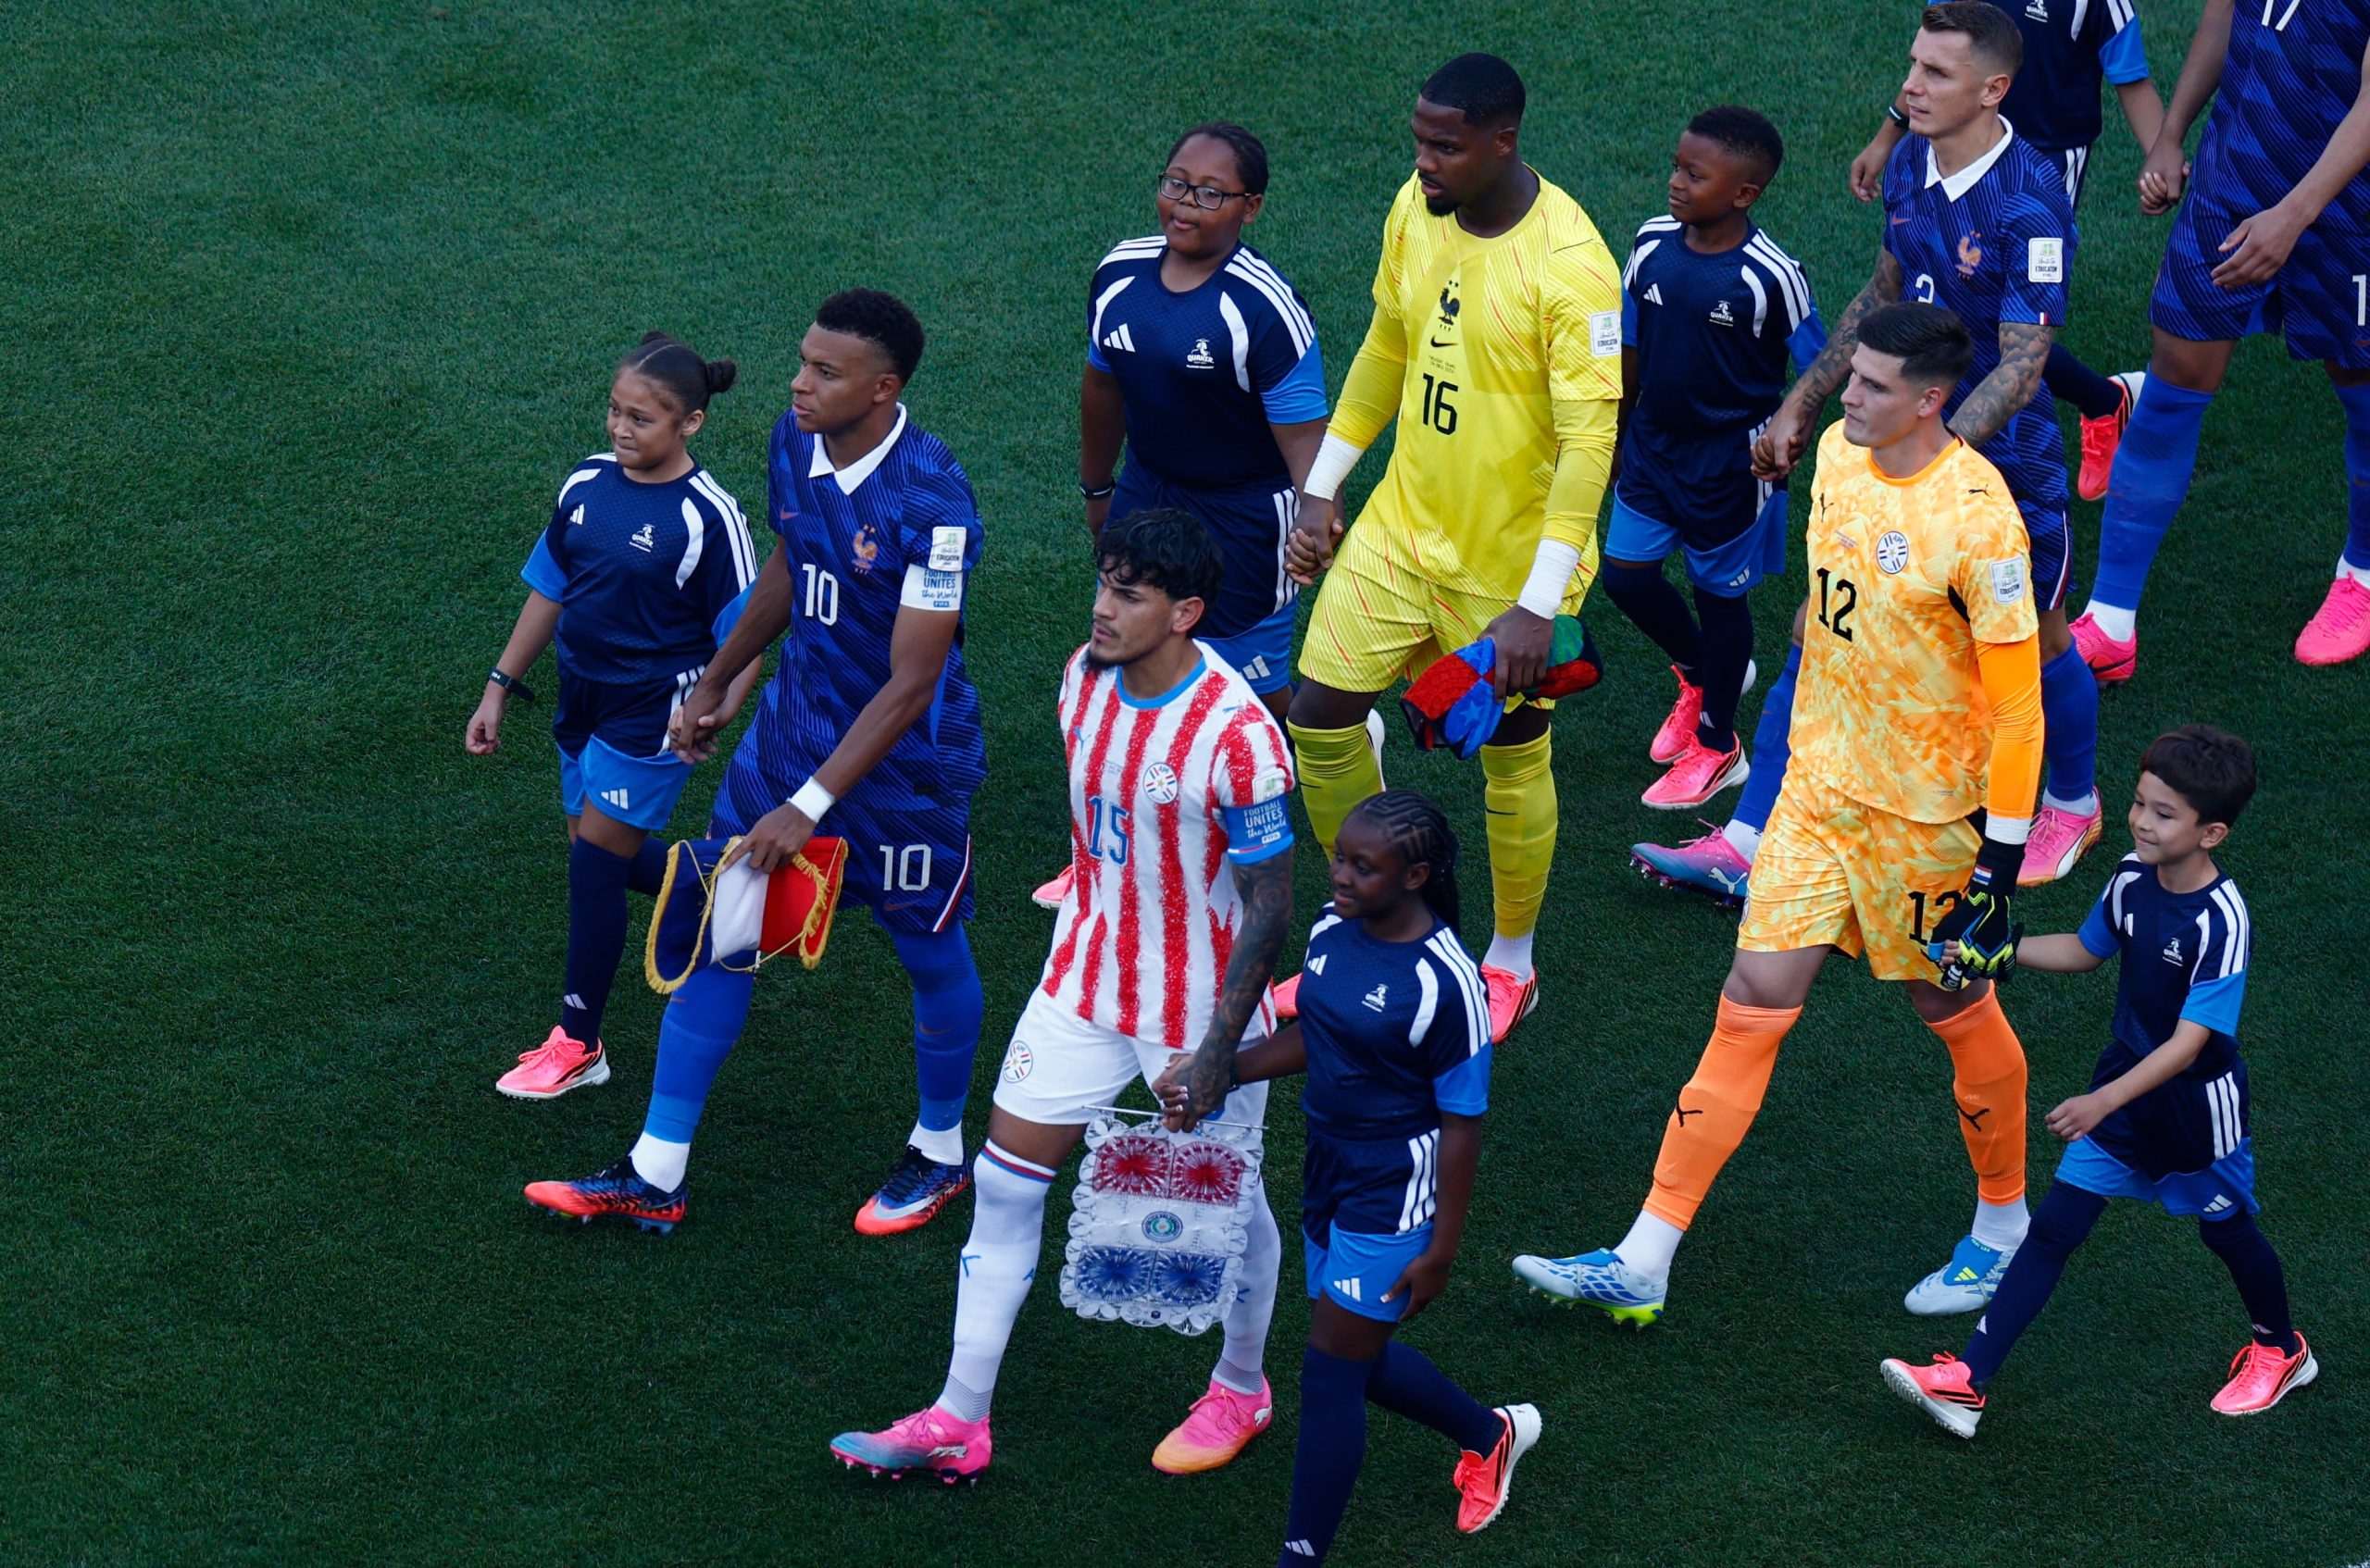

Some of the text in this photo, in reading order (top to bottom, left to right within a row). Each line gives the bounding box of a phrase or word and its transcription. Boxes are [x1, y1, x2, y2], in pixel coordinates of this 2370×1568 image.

[1422, 372, 1459, 436] 16
[802, 563, 839, 627] 10
[923, 578, 956, 590] UNITES
[1816, 566, 1857, 642] 12
[1088, 796, 1129, 865] 15
[1243, 799, 1281, 817] FOOTBALL
[1245, 806, 1284, 829] UNITES
[1246, 827, 1264, 839] the
[879, 843, 932, 891] 10
